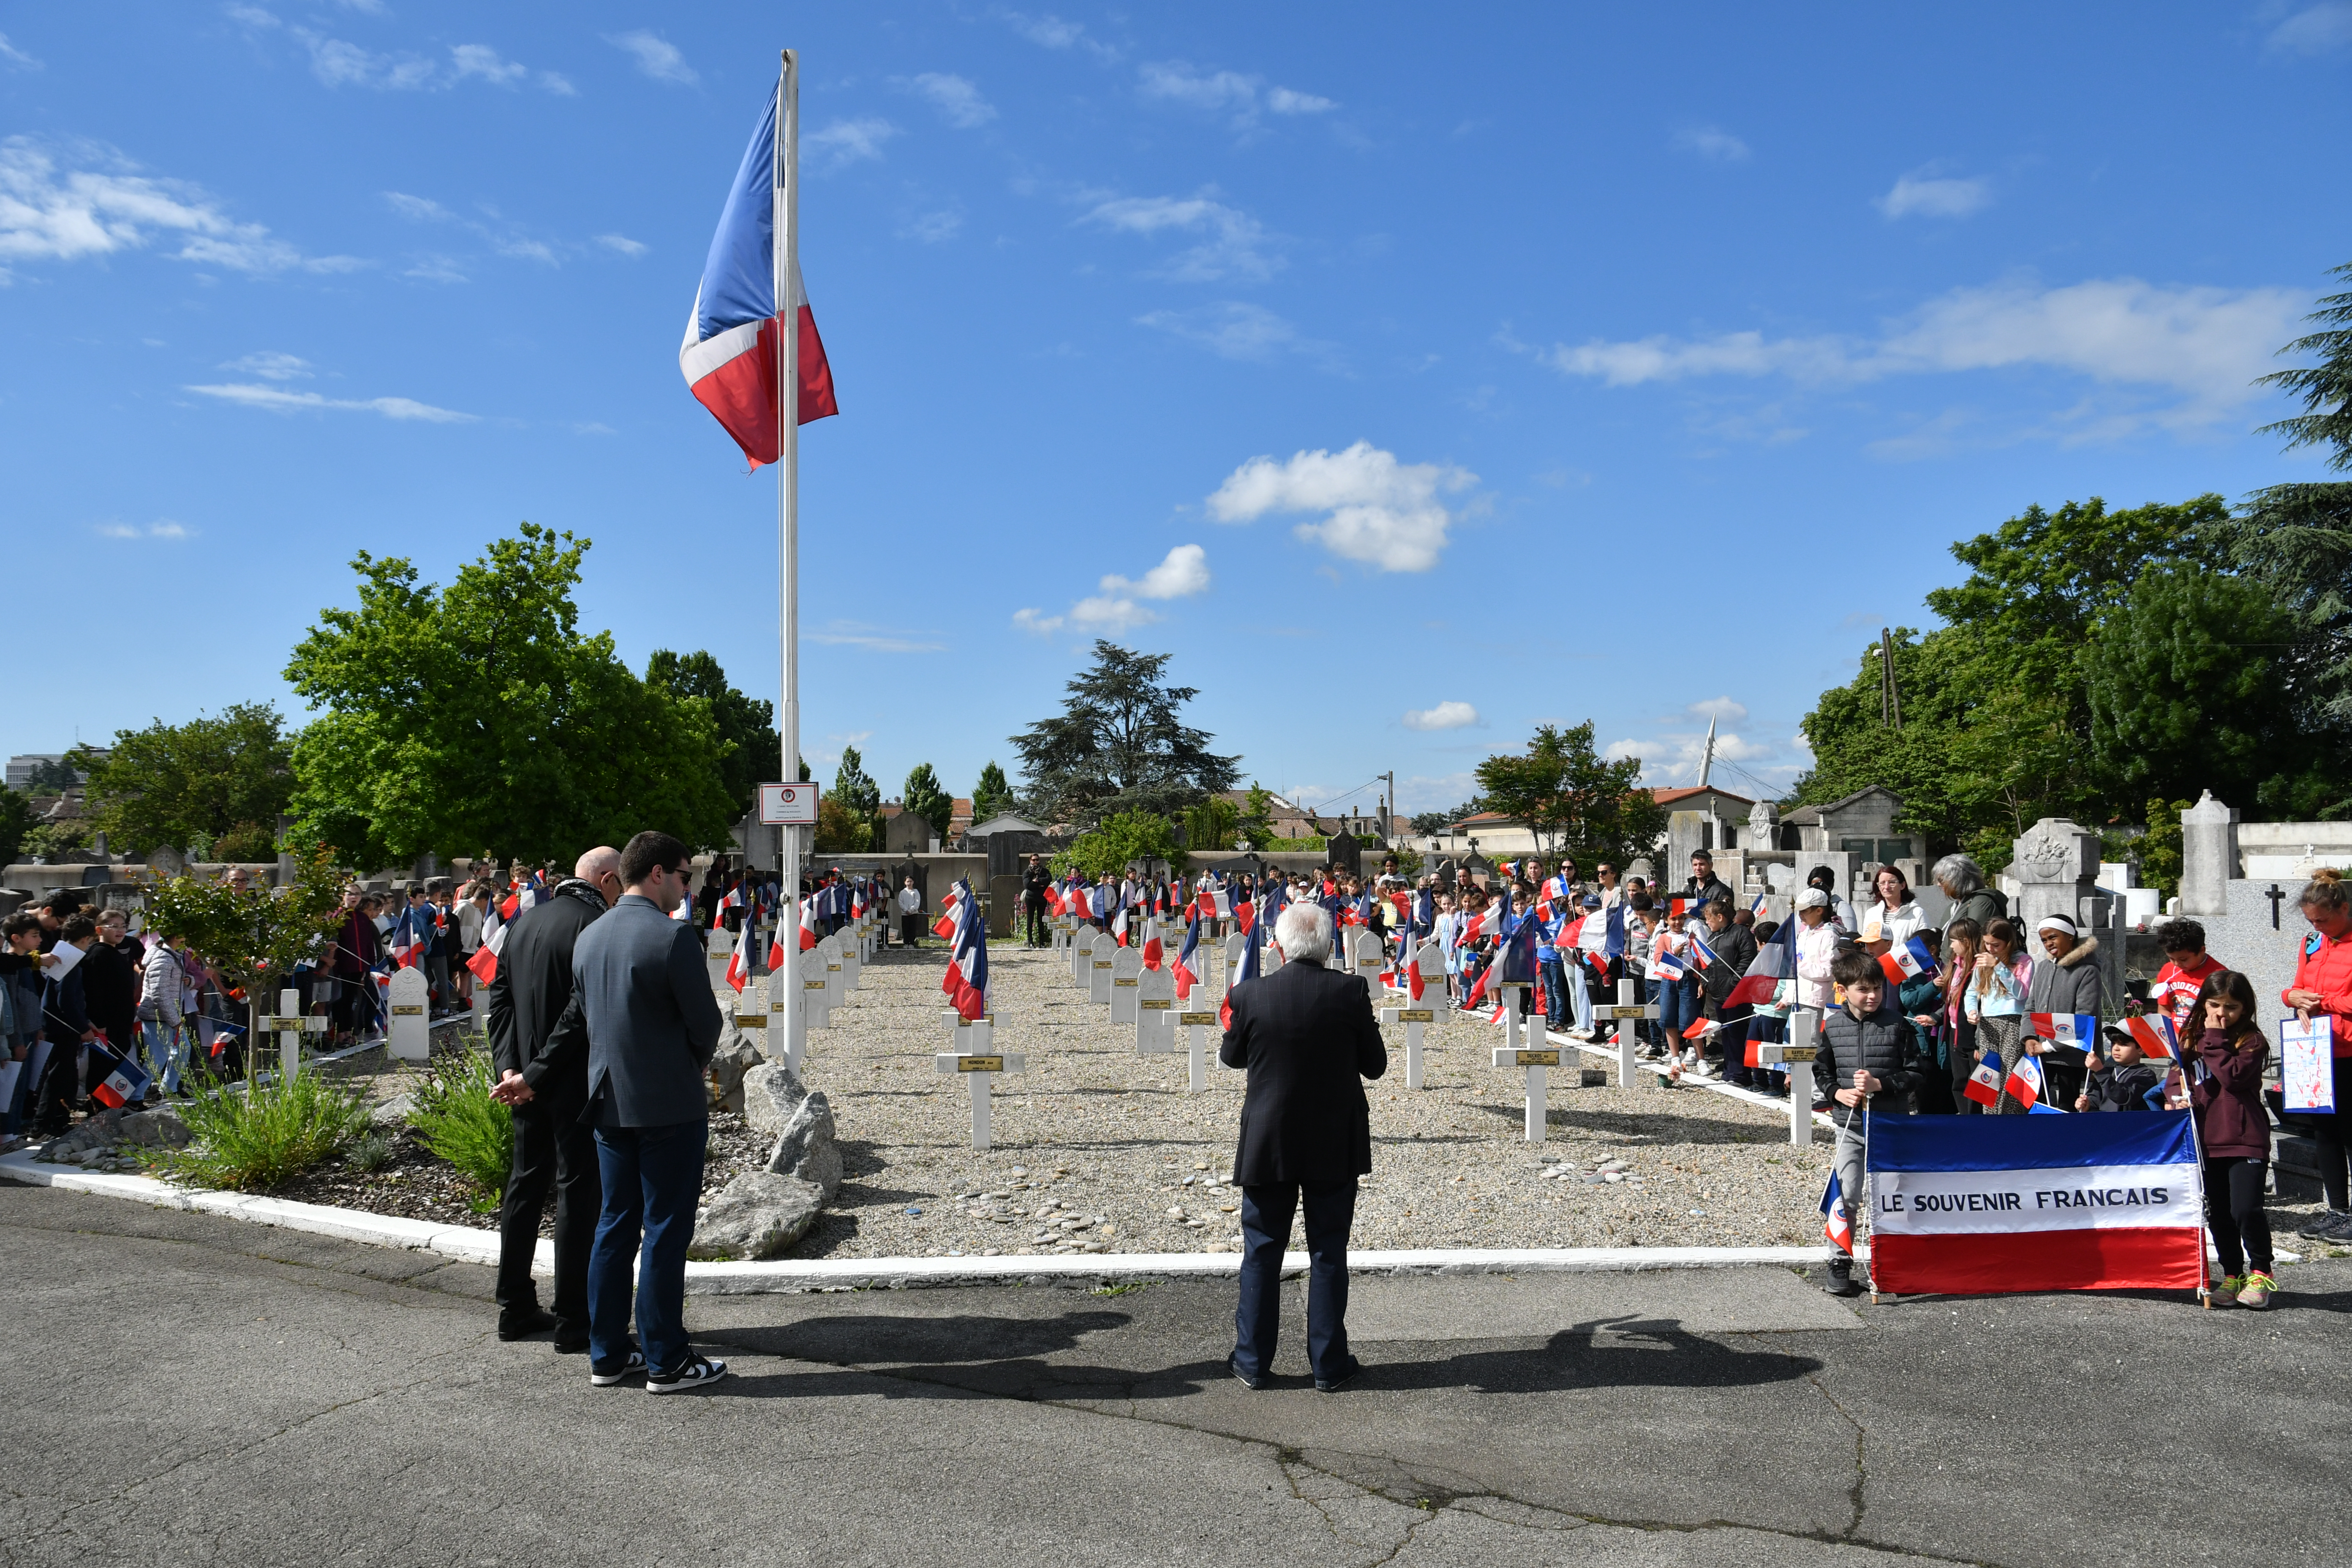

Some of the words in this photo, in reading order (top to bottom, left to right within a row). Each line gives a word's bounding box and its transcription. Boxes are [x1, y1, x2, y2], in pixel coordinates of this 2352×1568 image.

[2184, 983, 2200, 996] KAR
[1881, 1194, 1904, 1213] LE
[1914, 1192, 2022, 1212] SOUVENIR
